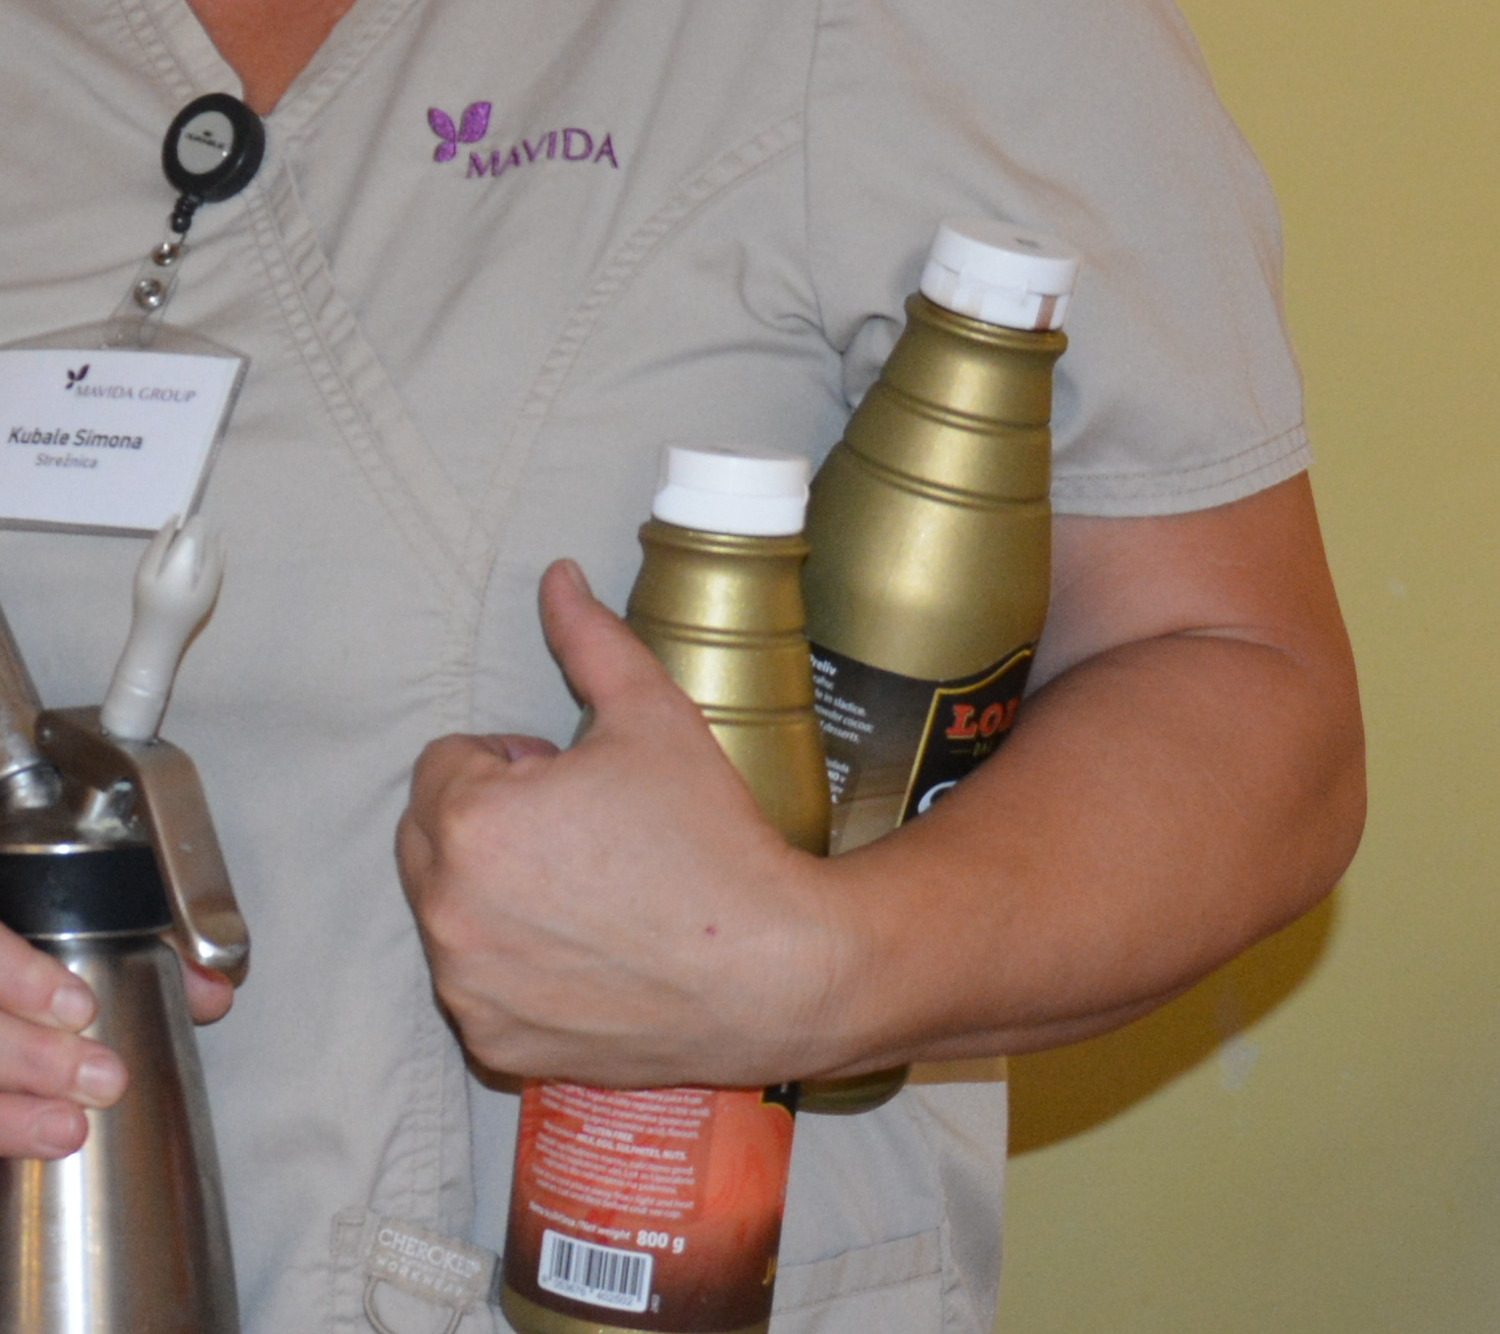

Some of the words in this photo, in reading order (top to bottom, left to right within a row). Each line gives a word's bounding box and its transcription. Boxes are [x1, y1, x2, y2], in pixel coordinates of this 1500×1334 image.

[466, 127, 618, 179] MAVIDA
[75, 384, 133, 400] MAVIDA
[138, 387, 197, 403] GROUP
[8, 426, 69, 446] Kubale
[73, 428, 143, 450] Simona
[35, 452, 98, 469] Strežnica
[636, 1229, 668, 1249] 800
[672, 1234, 685, 1255] g
